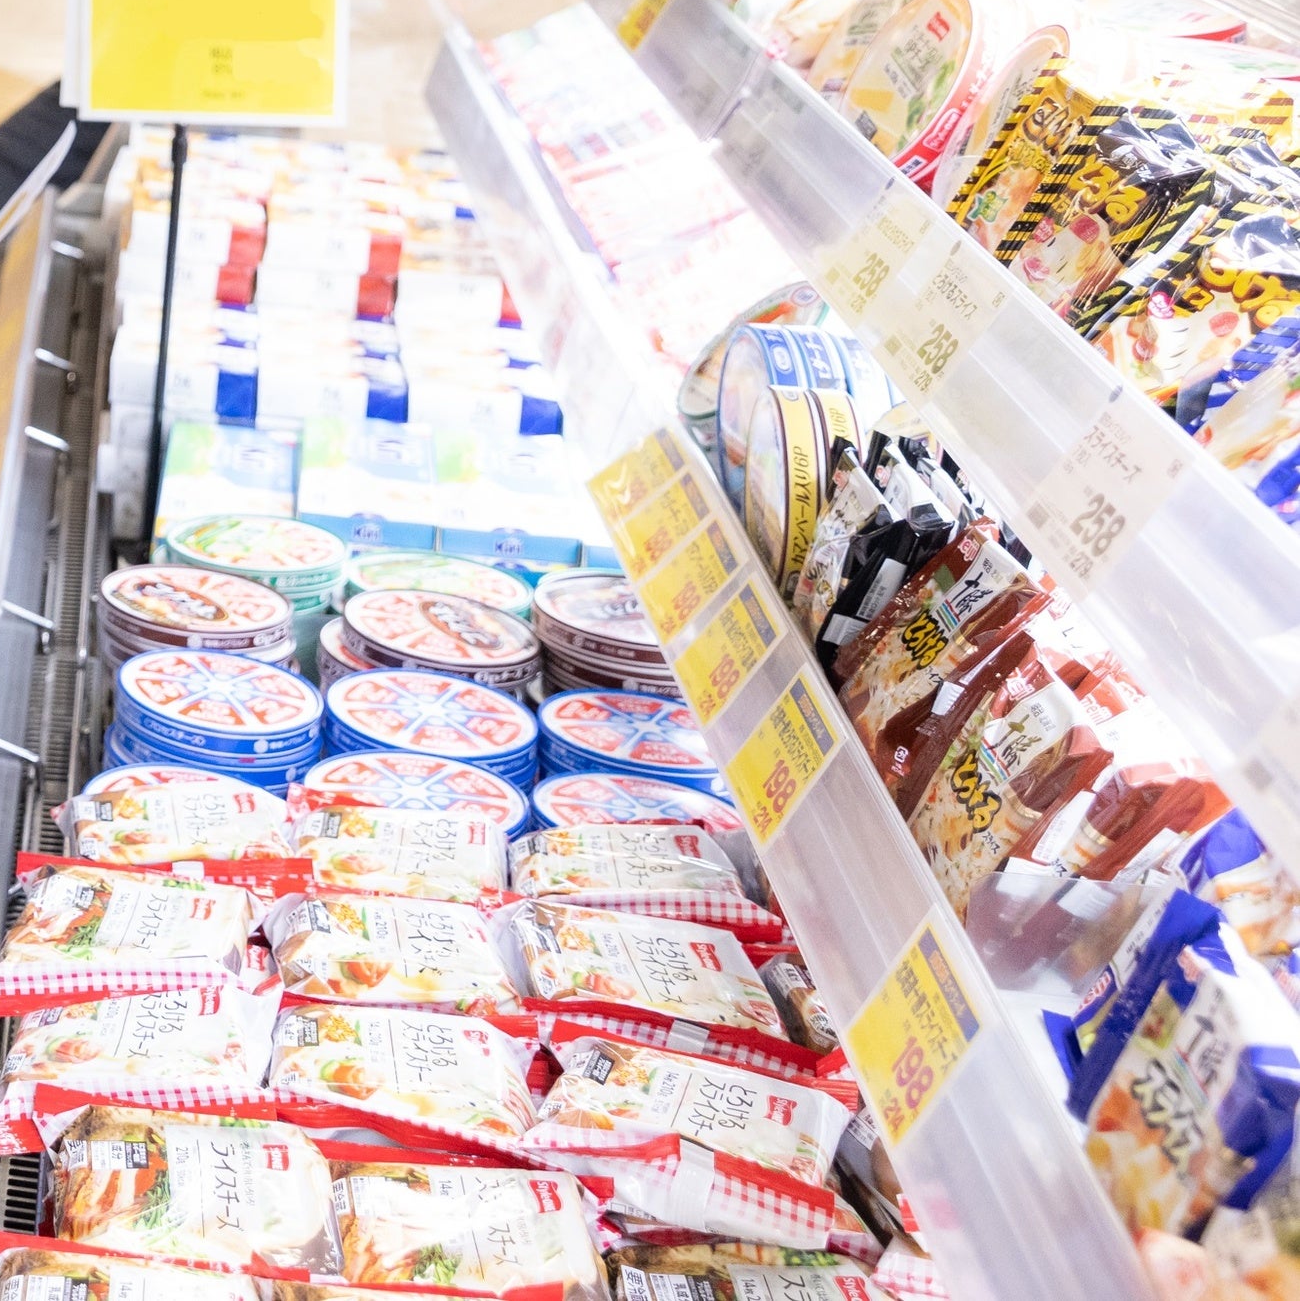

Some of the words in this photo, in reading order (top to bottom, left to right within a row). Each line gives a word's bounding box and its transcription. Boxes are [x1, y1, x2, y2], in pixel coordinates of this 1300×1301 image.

[852, 251, 891, 299] 258
[932, 273, 978, 321] とろけるスライス
[916, 323, 960, 375] 258
[913, 370, 934, 392] 279
[1083, 425, 1142, 484] スライスチーズ
[791, 445, 813, 567] カマンベール入り6P
[1069, 493, 1126, 558] 258
[1069, 550, 1094, 579] 279
[673, 580, 701, 622] 198
[951, 571, 994, 617] 十勝
[901, 609, 949, 671] とろける
[708, 652, 741, 700] 198
[991, 713, 1044, 770] 十勝
[761, 759, 798, 814] 198
[951, 751, 1002, 834] とろける
[752, 805, 773, 836] 214
[132, 892, 169, 953] スライスチーズ
[631, 933, 692, 1006] スライスチーズ
[655, 936, 698, 984] とろける
[401, 1019, 433, 1087] スライスチー
[426, 1024, 458, 1068] とろける
[891, 1035, 935, 1110] 198
[687, 1077, 727, 1137] スライスチー
[718, 1084, 757, 1130] とろける
[883, 1097, 906, 1134] 214
[210, 1140, 245, 1233] ライスチーズ
[534, 1179, 557, 1213] StyleONE
